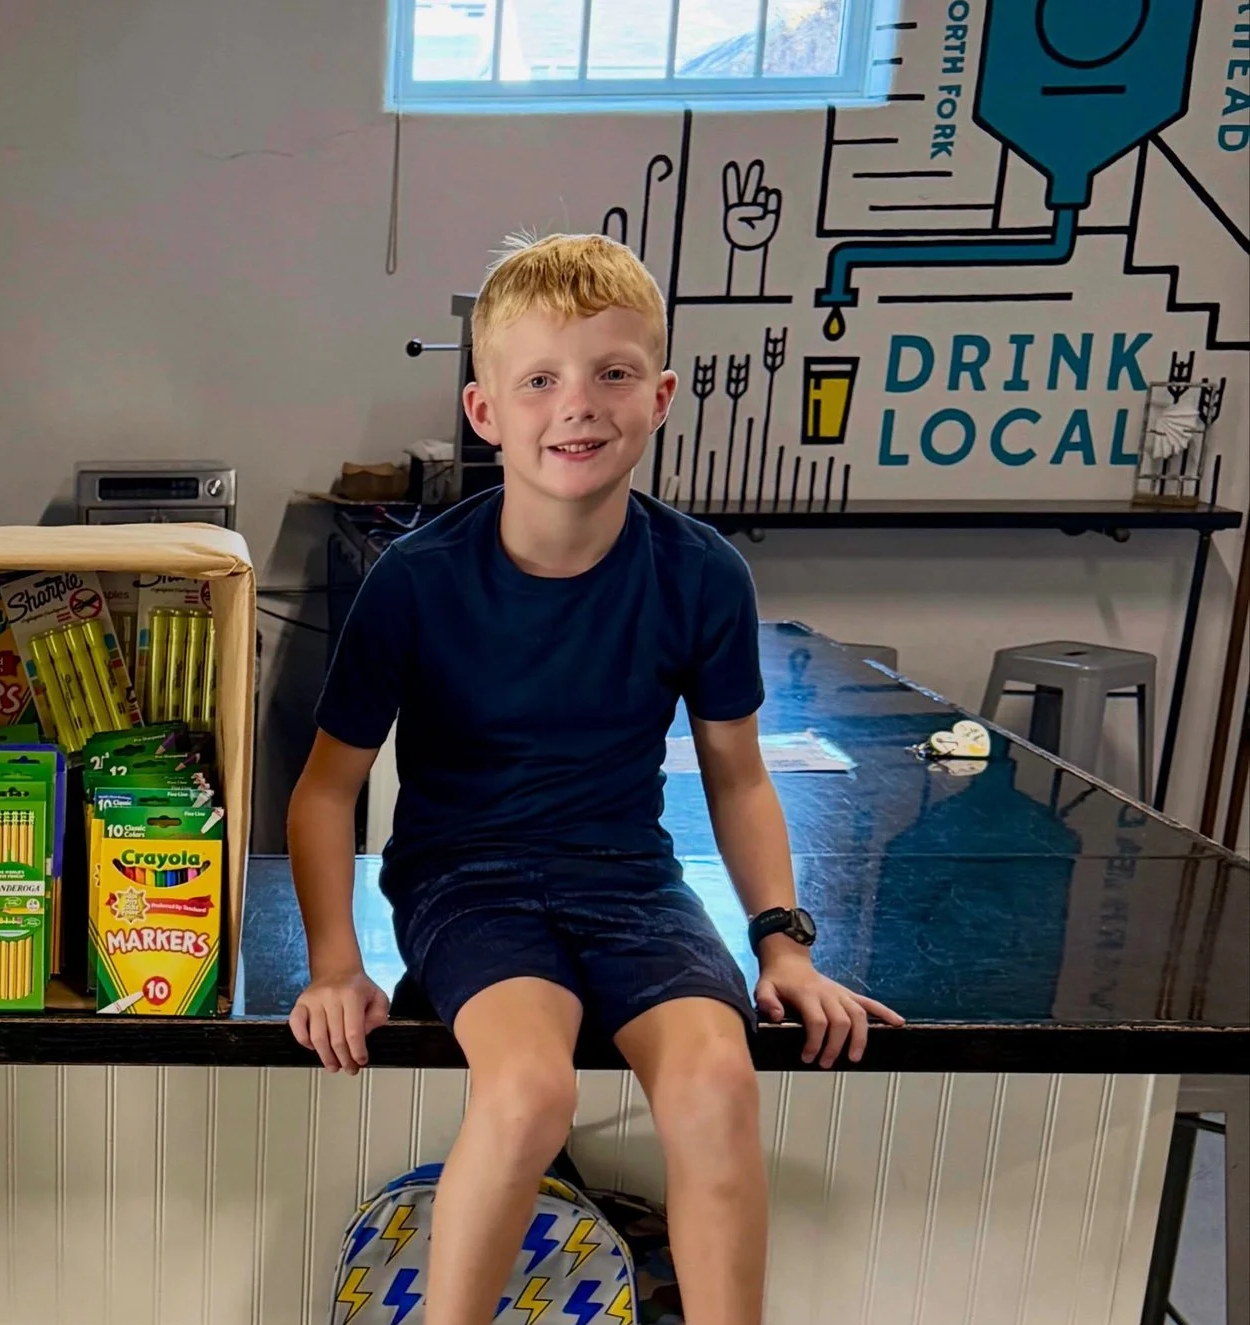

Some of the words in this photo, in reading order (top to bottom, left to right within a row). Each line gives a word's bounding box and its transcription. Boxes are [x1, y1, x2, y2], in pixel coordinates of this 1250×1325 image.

[930, 84, 962, 160] FORK
[884, 332, 1153, 393] DRINK
[878, 407, 1140, 466] LOCAL
[6, 572, 84, 624] Sharpie
[107, 824, 124, 837] 10
[124, 824, 146, 832] Classic
[121, 849, 201, 868] Crayola
[106, 927, 210, 958] MARKERS
[146, 980, 169, 1000] 10
